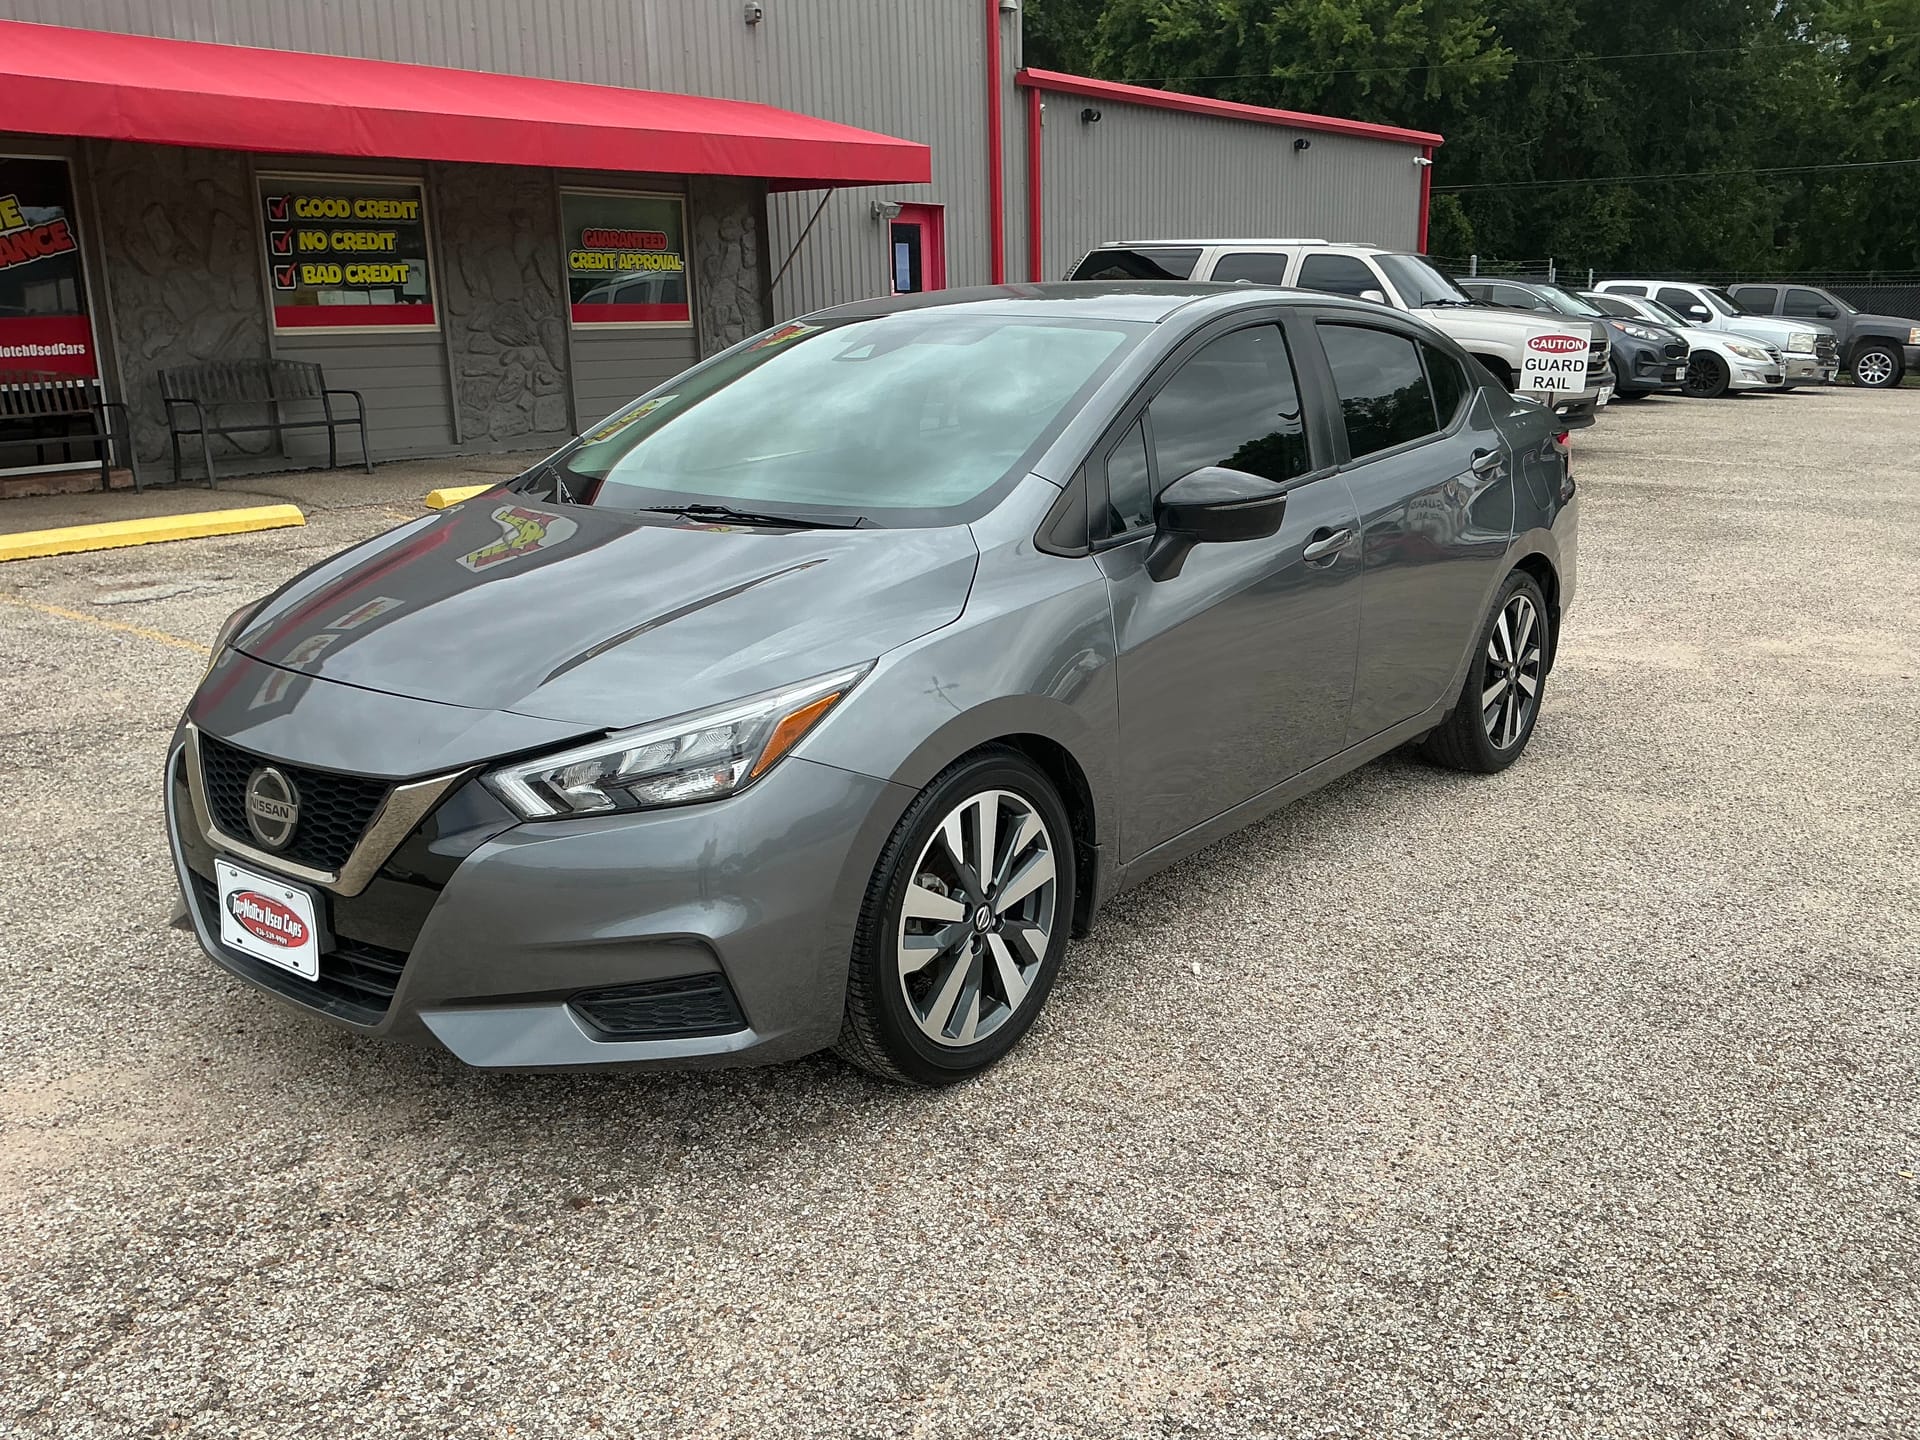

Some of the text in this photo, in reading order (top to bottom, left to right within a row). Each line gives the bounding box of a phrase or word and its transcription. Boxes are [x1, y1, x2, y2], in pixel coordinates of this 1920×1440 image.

[295, 197, 418, 220] GOOD CREDIT
[298, 231, 396, 251] NO CREDIT
[582, 229, 668, 250] GUARANTEED
[569, 251, 683, 272] CREDIT APPROVAL
[301, 264, 410, 286] BAD CREDIT
[1530, 338, 1585, 350] CAUTION
[1525, 358, 1585, 373] GUARD
[1532, 376, 1571, 390] RAIL
[252, 797, 289, 819] NISSAN
